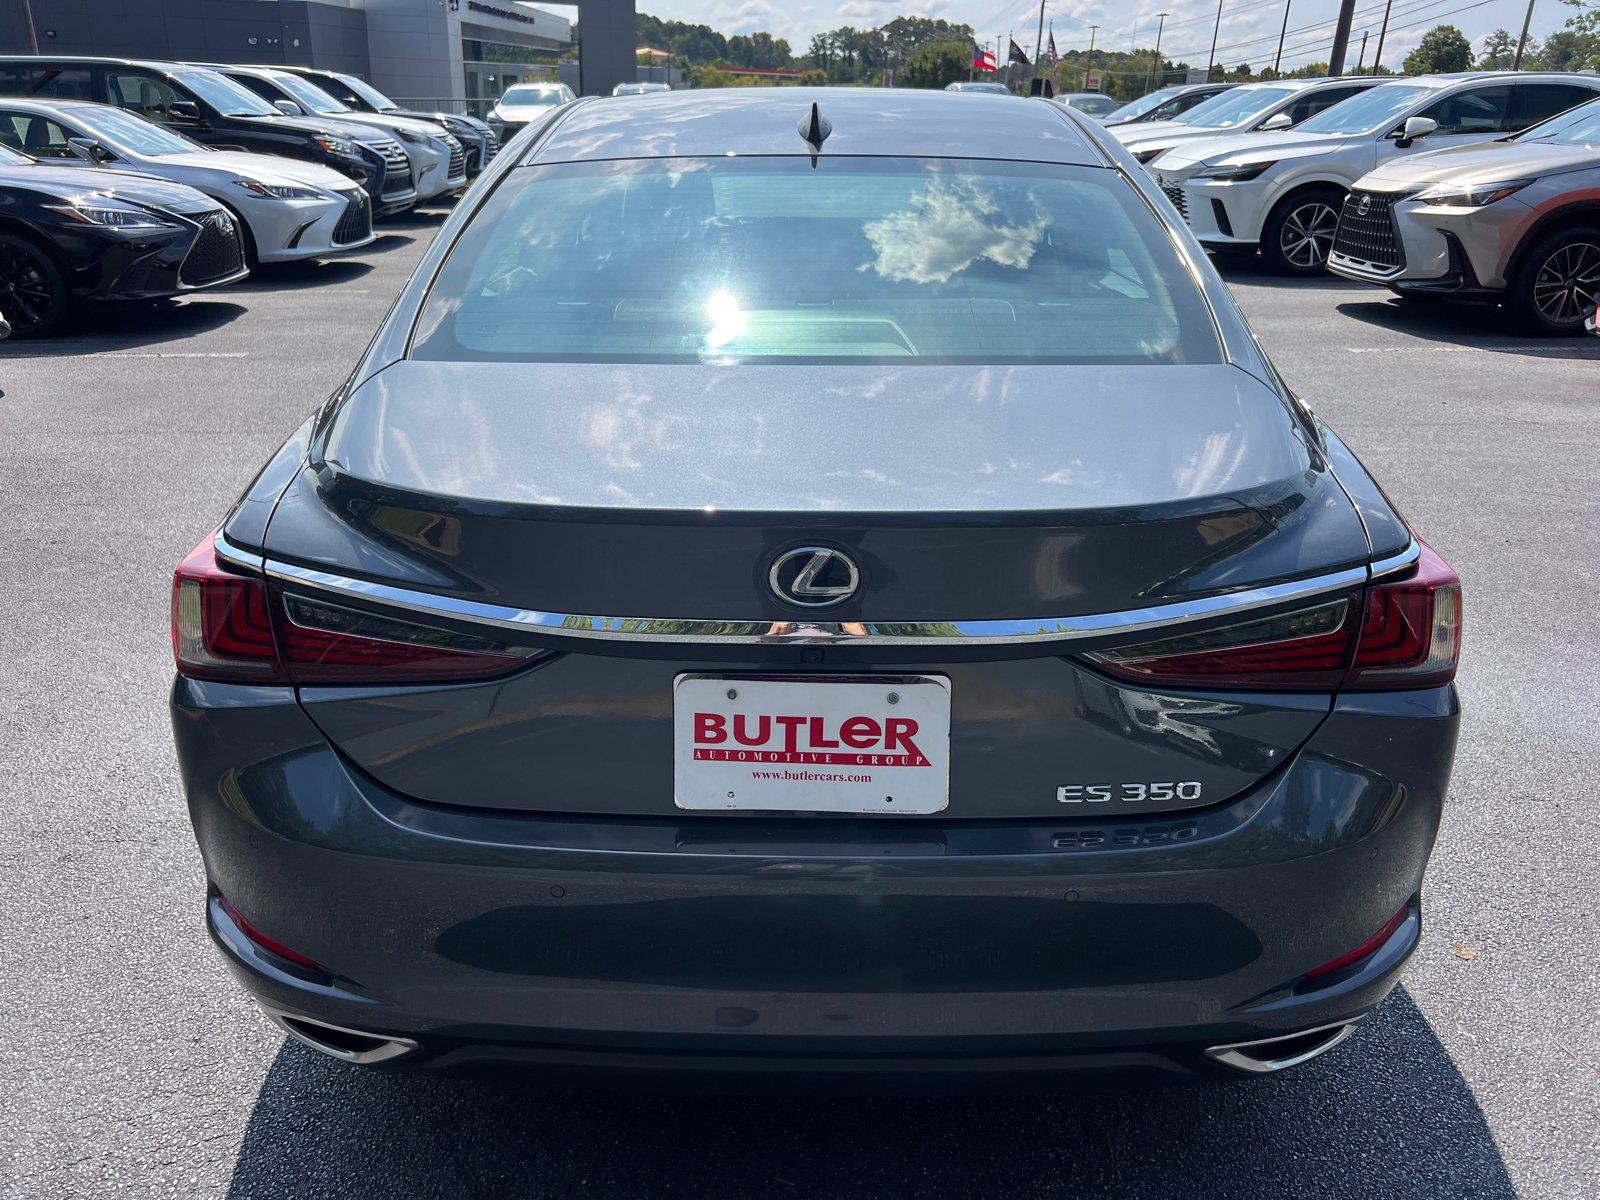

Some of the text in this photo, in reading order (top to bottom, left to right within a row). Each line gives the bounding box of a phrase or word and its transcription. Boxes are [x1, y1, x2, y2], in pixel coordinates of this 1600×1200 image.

[695, 750, 923, 766] AUTOMOTIVE GROUP
[752, 769, 872, 783] www.butlercars.com
[1057, 781, 1202, 803] ES 350
